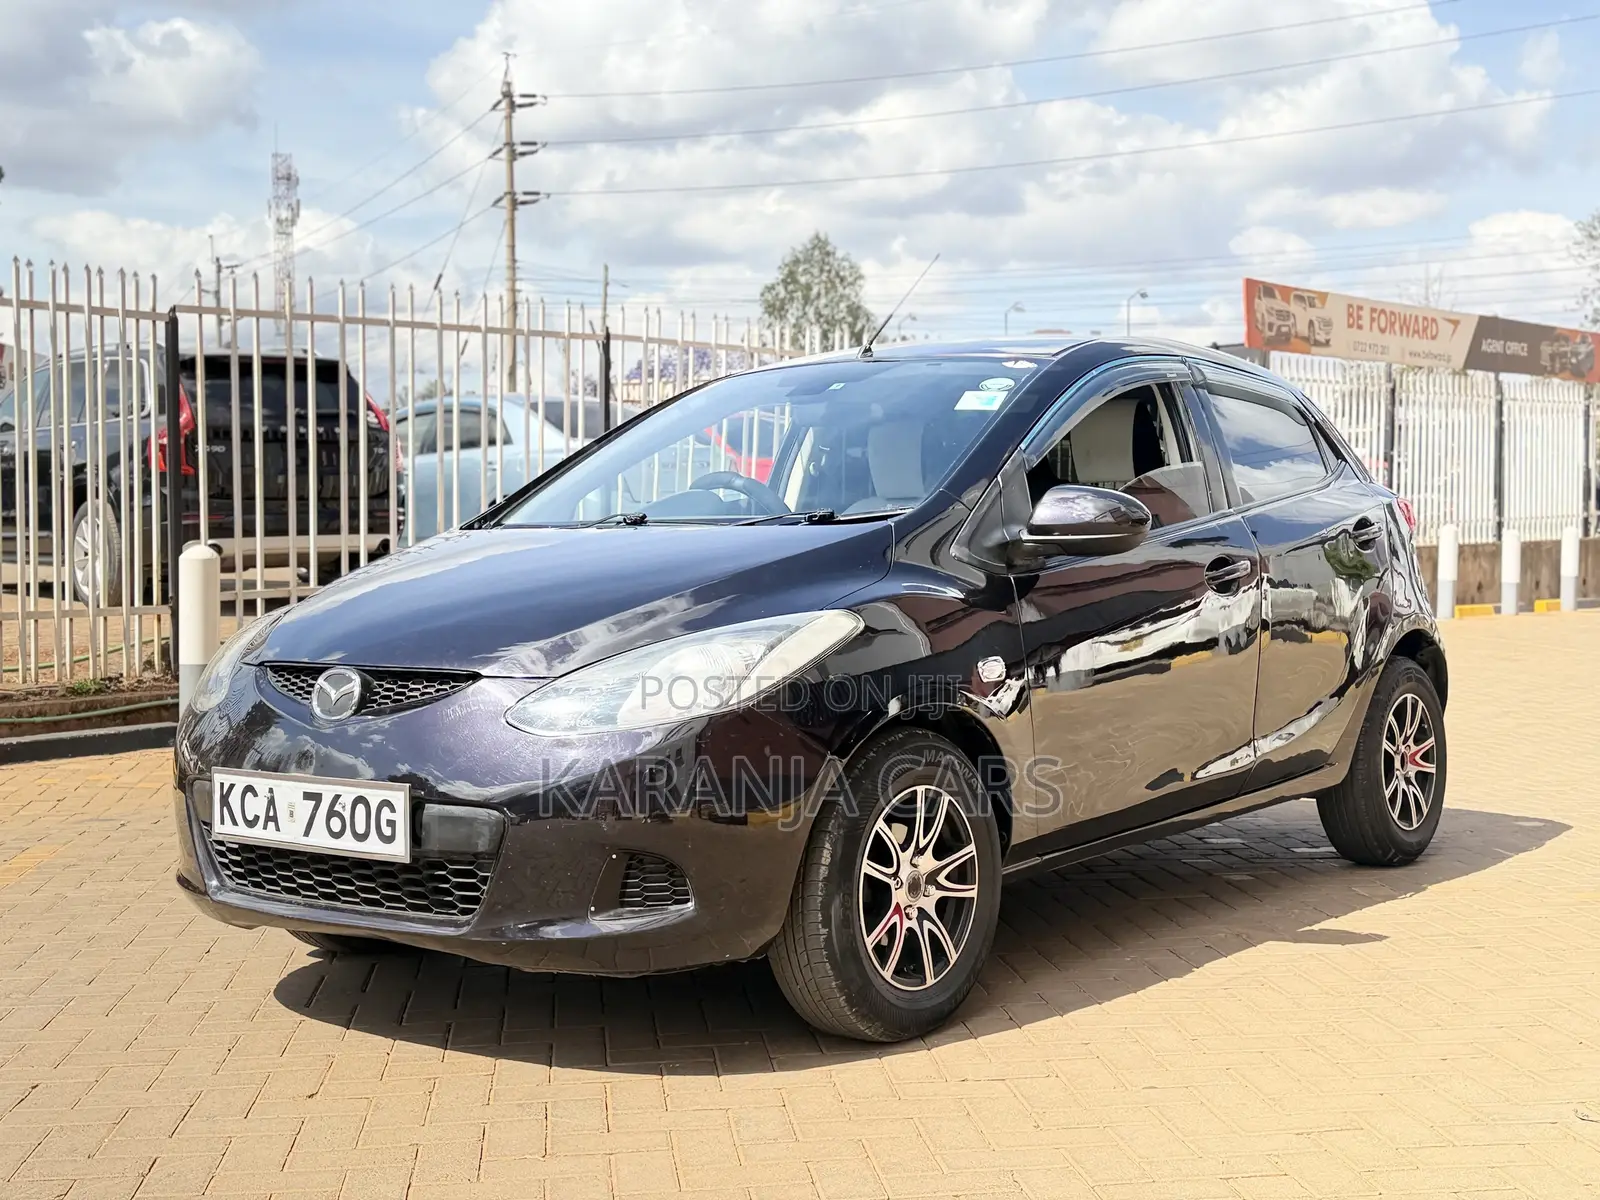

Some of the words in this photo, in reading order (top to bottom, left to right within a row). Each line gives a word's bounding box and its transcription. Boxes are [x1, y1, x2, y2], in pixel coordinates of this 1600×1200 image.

[1346, 303, 1364, 331] BE
[1369, 306, 1439, 341] FORWARD
[1481, 337, 1504, 354] AGENT
[1505, 340, 1528, 356] OFFICE
[219, 782, 281, 832] KCA
[302, 791, 397, 845] 760G
